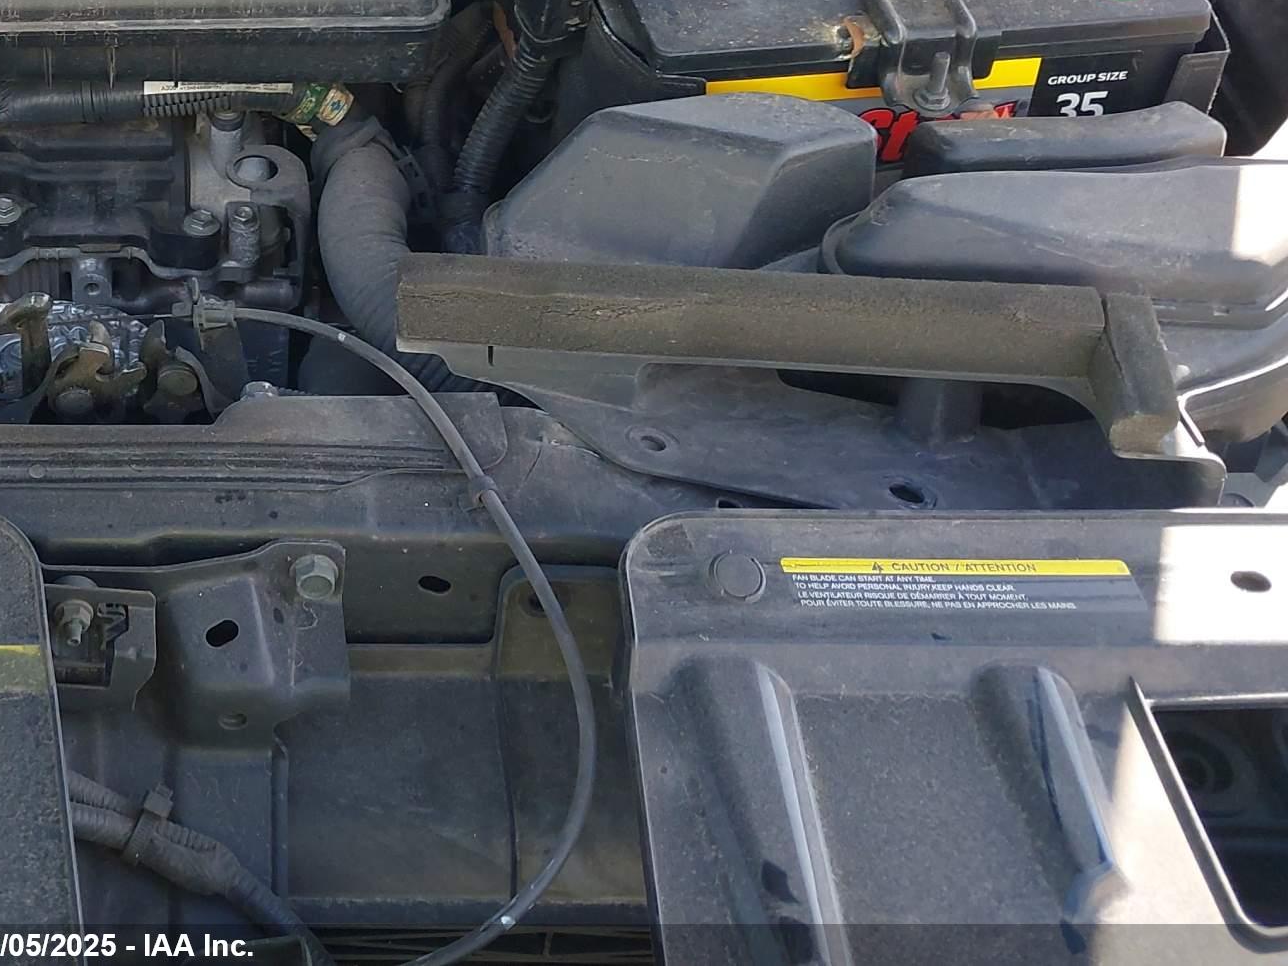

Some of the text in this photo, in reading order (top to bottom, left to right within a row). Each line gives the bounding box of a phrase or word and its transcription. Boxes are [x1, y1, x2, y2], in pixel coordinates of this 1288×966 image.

[1047, 70, 1129, 86] GROUP SIZE
[1055, 91, 1109, 117] 35
[892, 562, 949, 571] CAUTION
[965, 563, 1037, 572] ATTENTION
[808, 582, 829, 590] HELP
[912, 591, 955, 601] DÉMARRER
[966, 593, 987, 601] TOUT
[827, 599, 854, 608] ÉVITER
[856, 600, 882, 608] TOUTE
